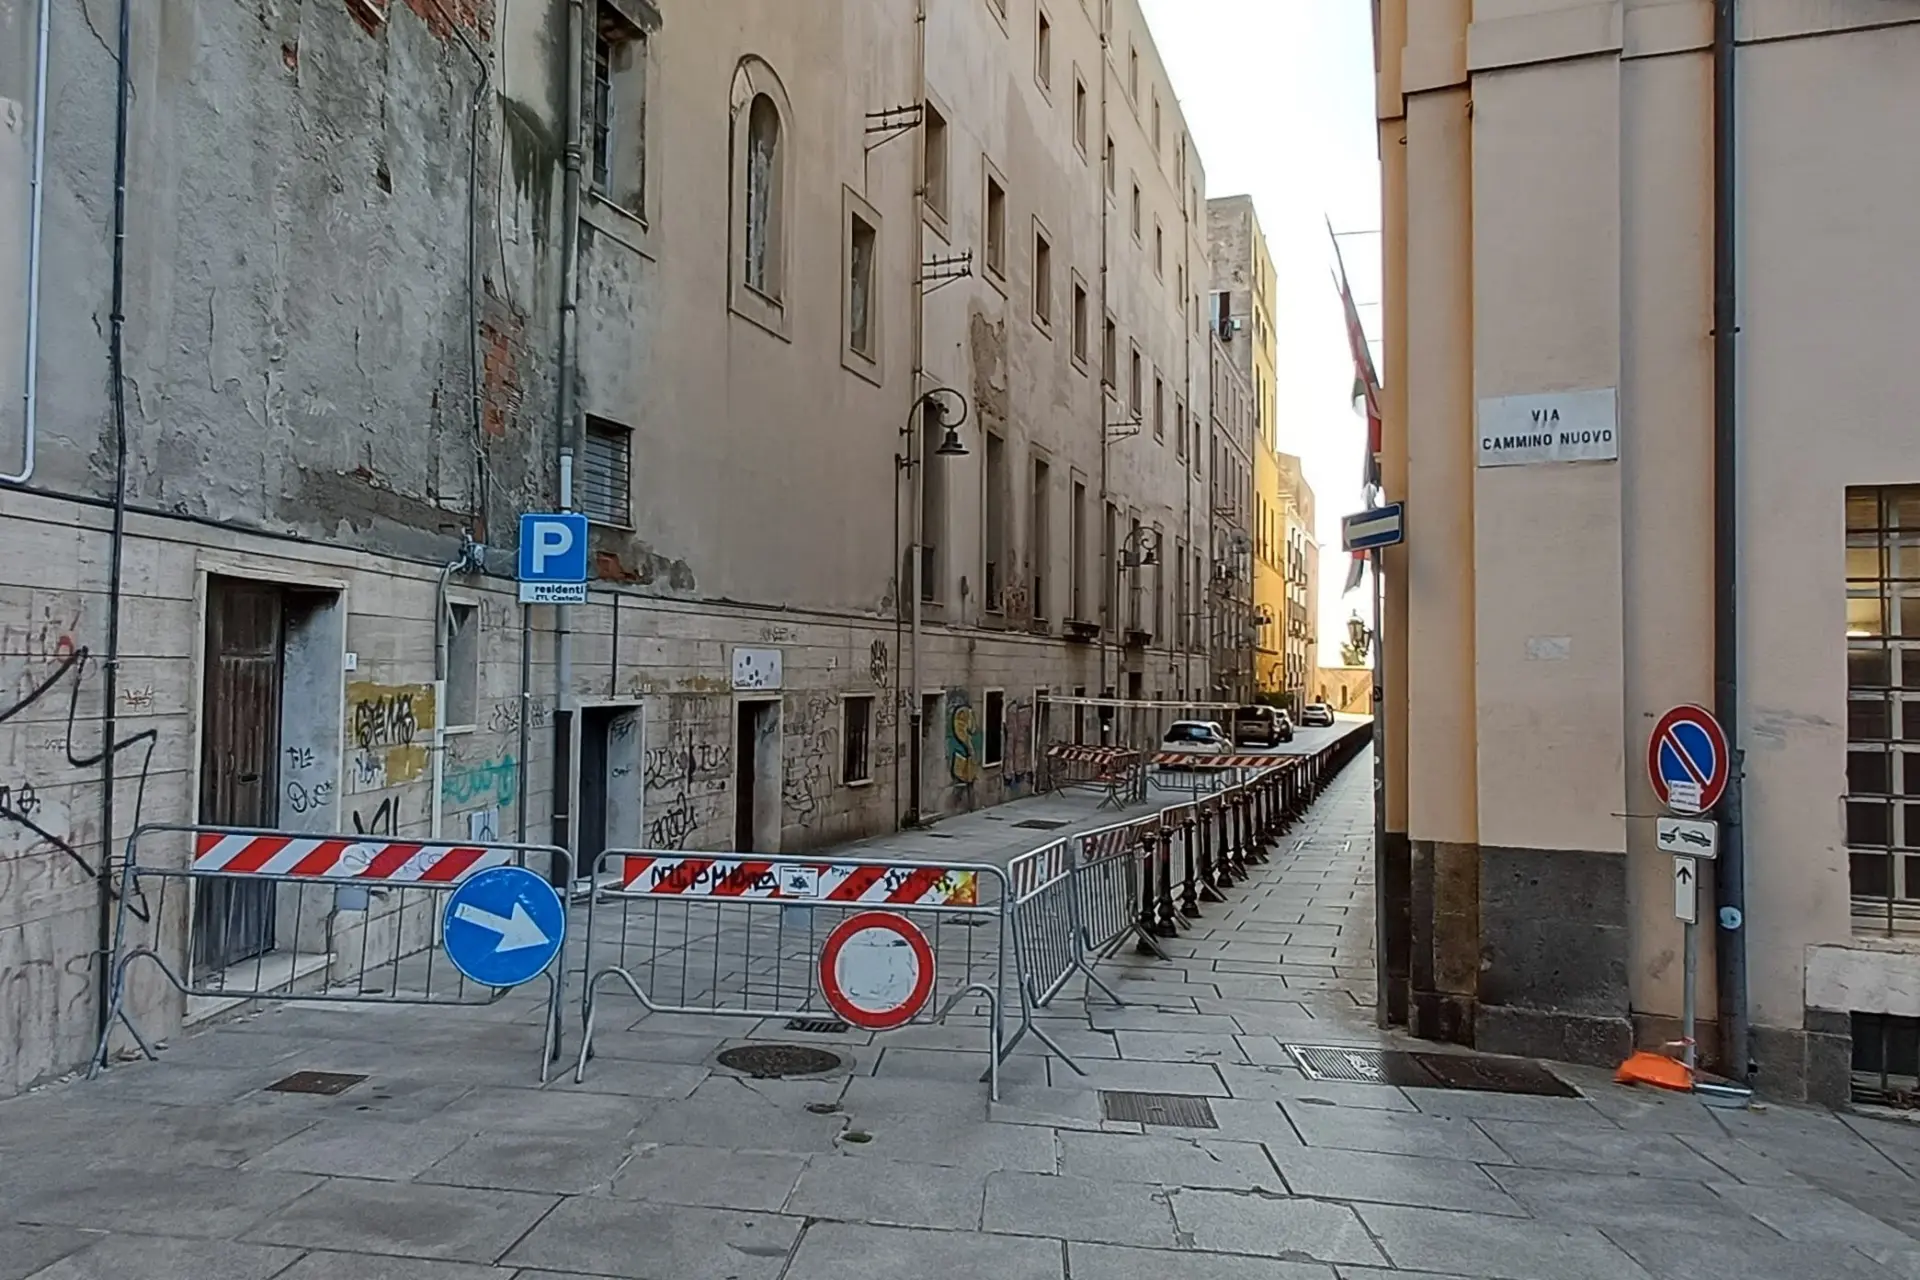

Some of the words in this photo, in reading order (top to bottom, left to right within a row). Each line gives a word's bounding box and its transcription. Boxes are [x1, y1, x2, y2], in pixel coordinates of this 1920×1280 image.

[1531, 408, 1561, 422] VIA
[1482, 433, 1553, 451] CAMMINO
[1559, 429, 1613, 445] NUOVO
[532, 521, 573, 574] P
[534, 585, 584, 594] residenti
